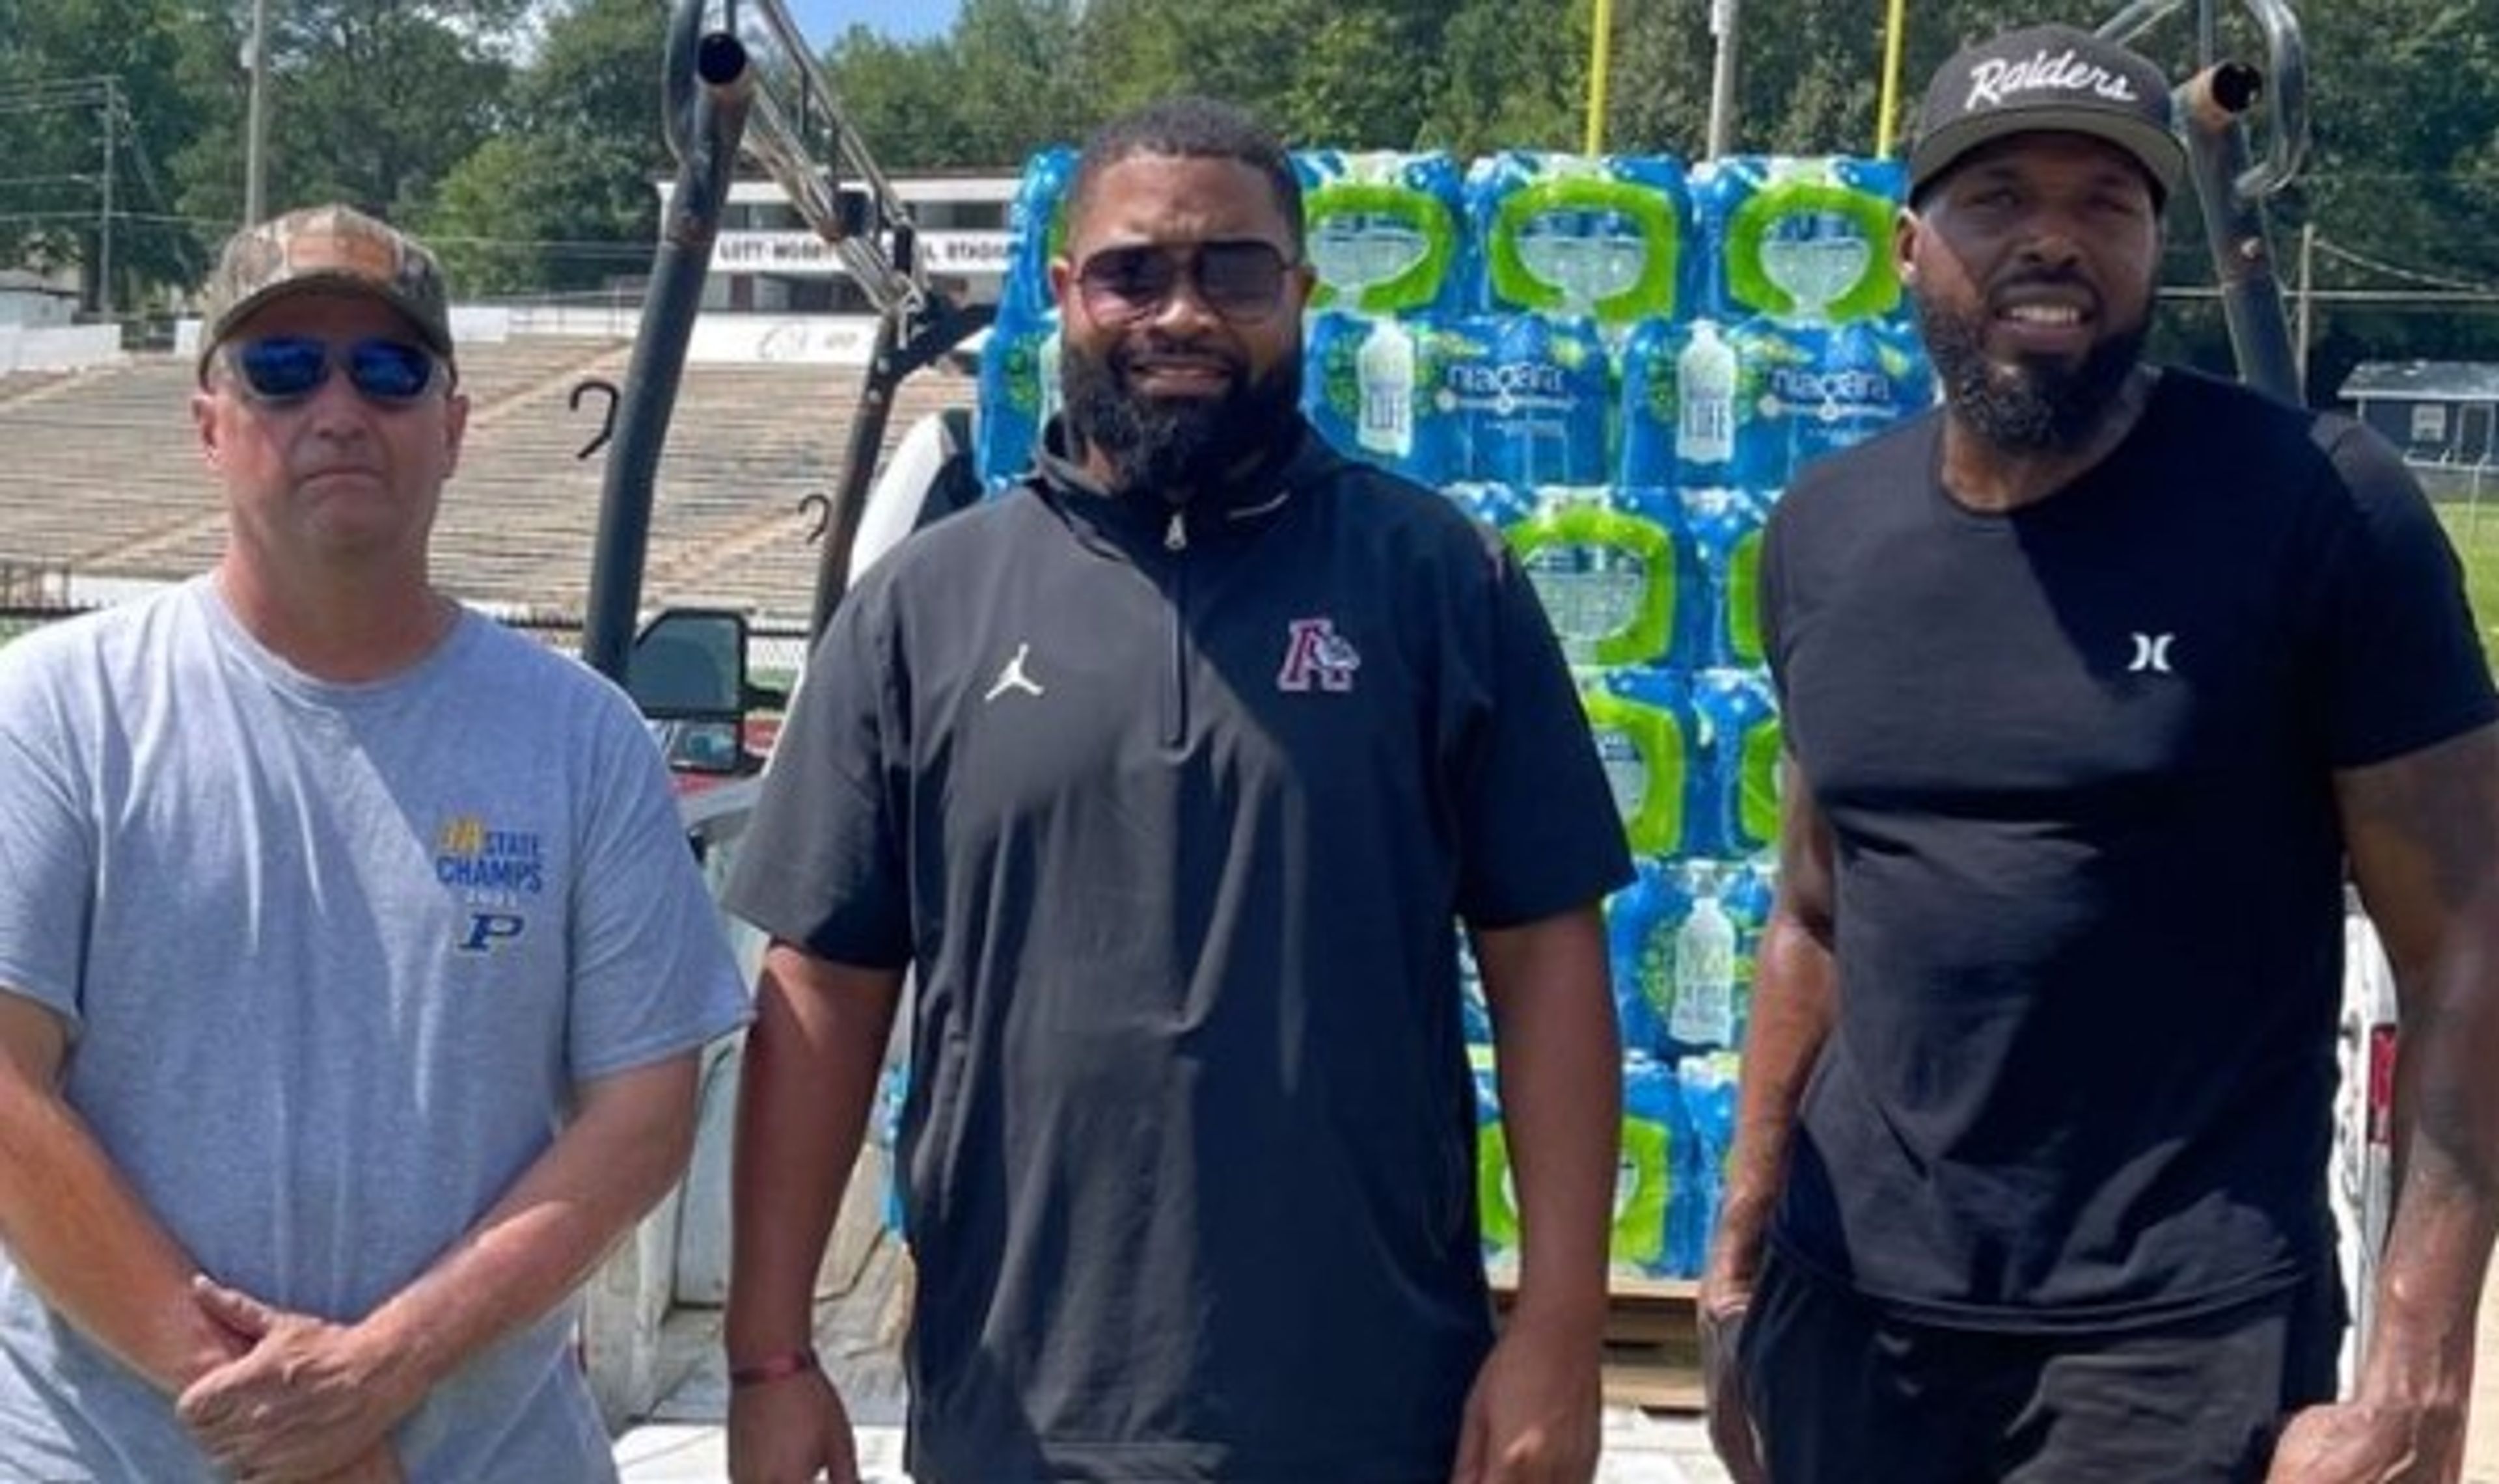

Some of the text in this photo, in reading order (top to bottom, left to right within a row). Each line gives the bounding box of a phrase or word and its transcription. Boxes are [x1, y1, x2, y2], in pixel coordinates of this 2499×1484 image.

[1964, 49, 2138, 111] Raiders
[437, 856, 541, 894] CHAMPS
[457, 913, 525, 951] P
